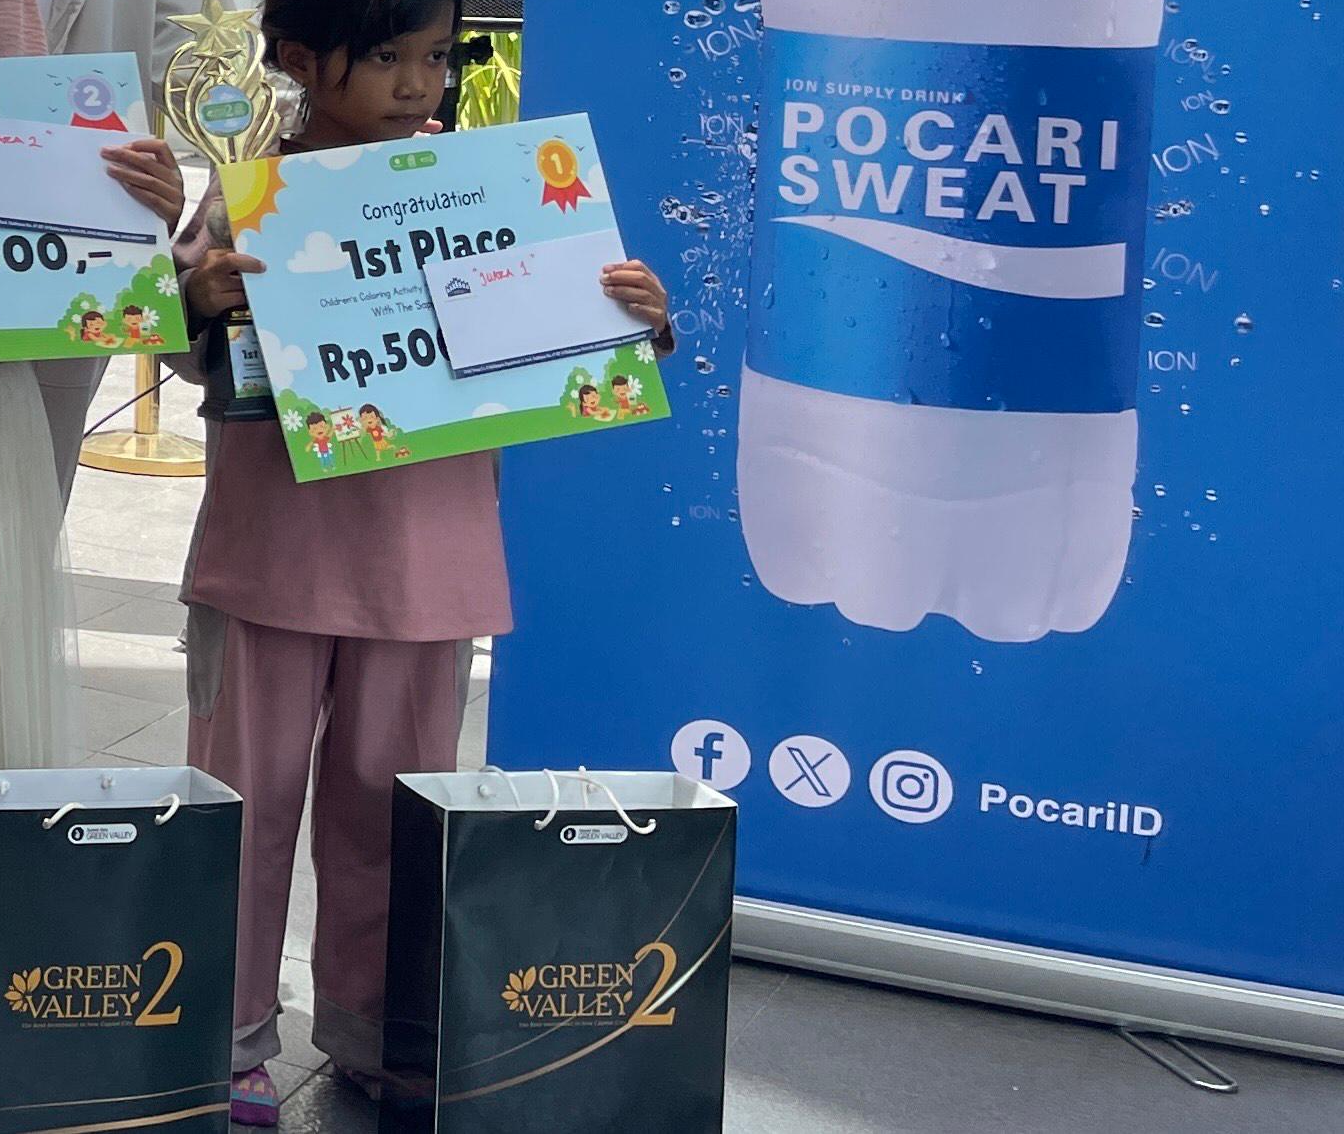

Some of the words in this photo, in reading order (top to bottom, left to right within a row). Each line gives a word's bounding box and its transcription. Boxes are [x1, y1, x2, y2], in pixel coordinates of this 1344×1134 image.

[698, 19, 758, 59] ION
[83, 85, 101, 106] 2
[785, 78, 818, 93] ION
[826, 82, 895, 101] SUPPLY
[901, 88, 965, 104] DRINK
[1180, 90, 1214, 111] ION
[782, 101, 1118, 171] POCARI
[550, 152, 563, 175] 1
[1152, 133, 1219, 177] ION
[778, 154, 1087, 224] SWEAT
[362, 185, 486, 225] Congratulation!
[340, 238, 402, 280] 1st
[408, 226, 516, 270] Place
[1151, 247, 1218, 293] ION
[320, 290, 358, 308] Children's
[359, 287, 391, 303] Coloring
[392, 283, 423, 297] Activity
[371, 304, 394, 317] With
[396, 301, 414, 313] The
[670, 308, 725, 335] ON
[1148, 350, 1197, 372] ION
[979, 782, 1164, 838] PocariID
[43, 964, 142, 990] GREEN
[135, 941, 184, 1027] 2
[538, 963, 634, 989] GREEN
[628, 942, 678, 1026] 2
[25, 992, 140, 1019] VALLEY
[522, 992, 633, 1017] VALLEY
